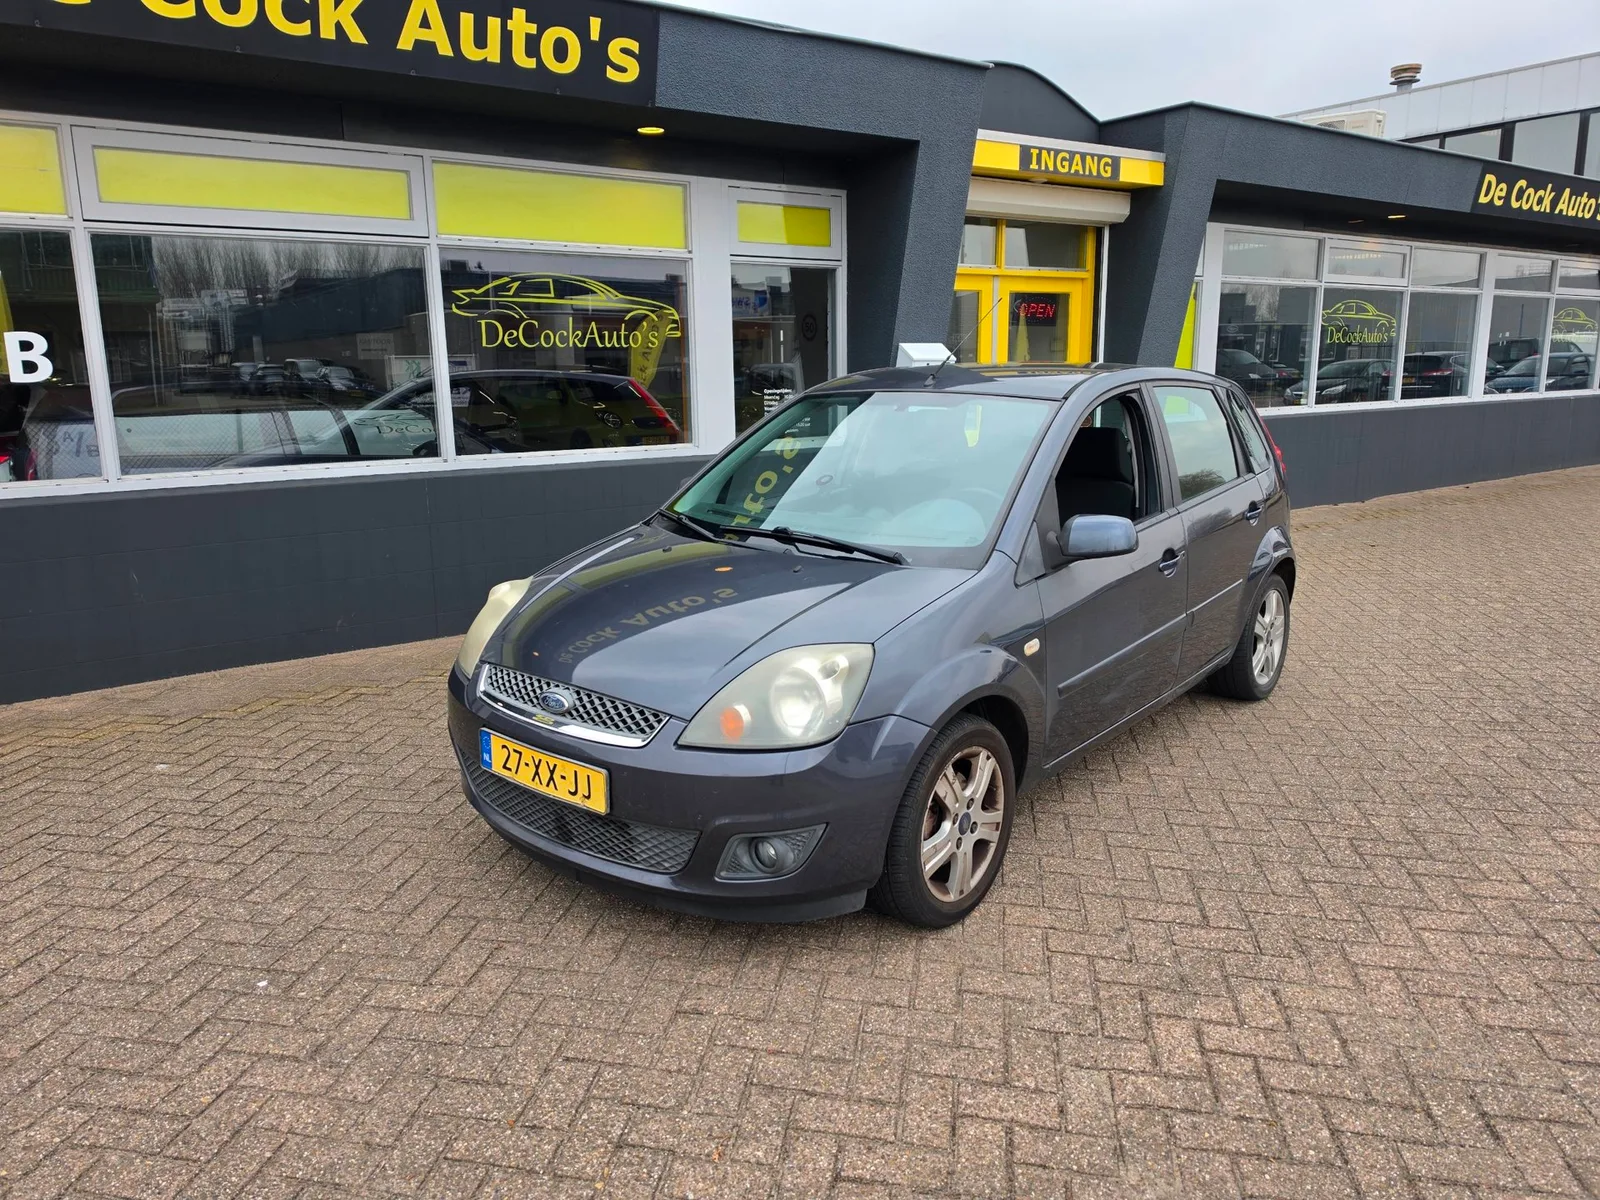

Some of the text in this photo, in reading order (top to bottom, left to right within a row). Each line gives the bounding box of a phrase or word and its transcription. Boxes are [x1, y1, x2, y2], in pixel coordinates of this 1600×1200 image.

[141, 0, 641, 83] ock Auto's
[1029, 148, 1112, 178] INGANG
[1478, 173, 1600, 221] De Cock Auto
[1018, 303, 1056, 318] OPEN
[477, 317, 658, 348] DeCockAuto's
[1327, 325, 1389, 343] DeCockAuto's
[4, 331, 54, 383] B
[483, 752, 492, 763] NL
[500, 744, 592, 800] 27-XX-JJ
